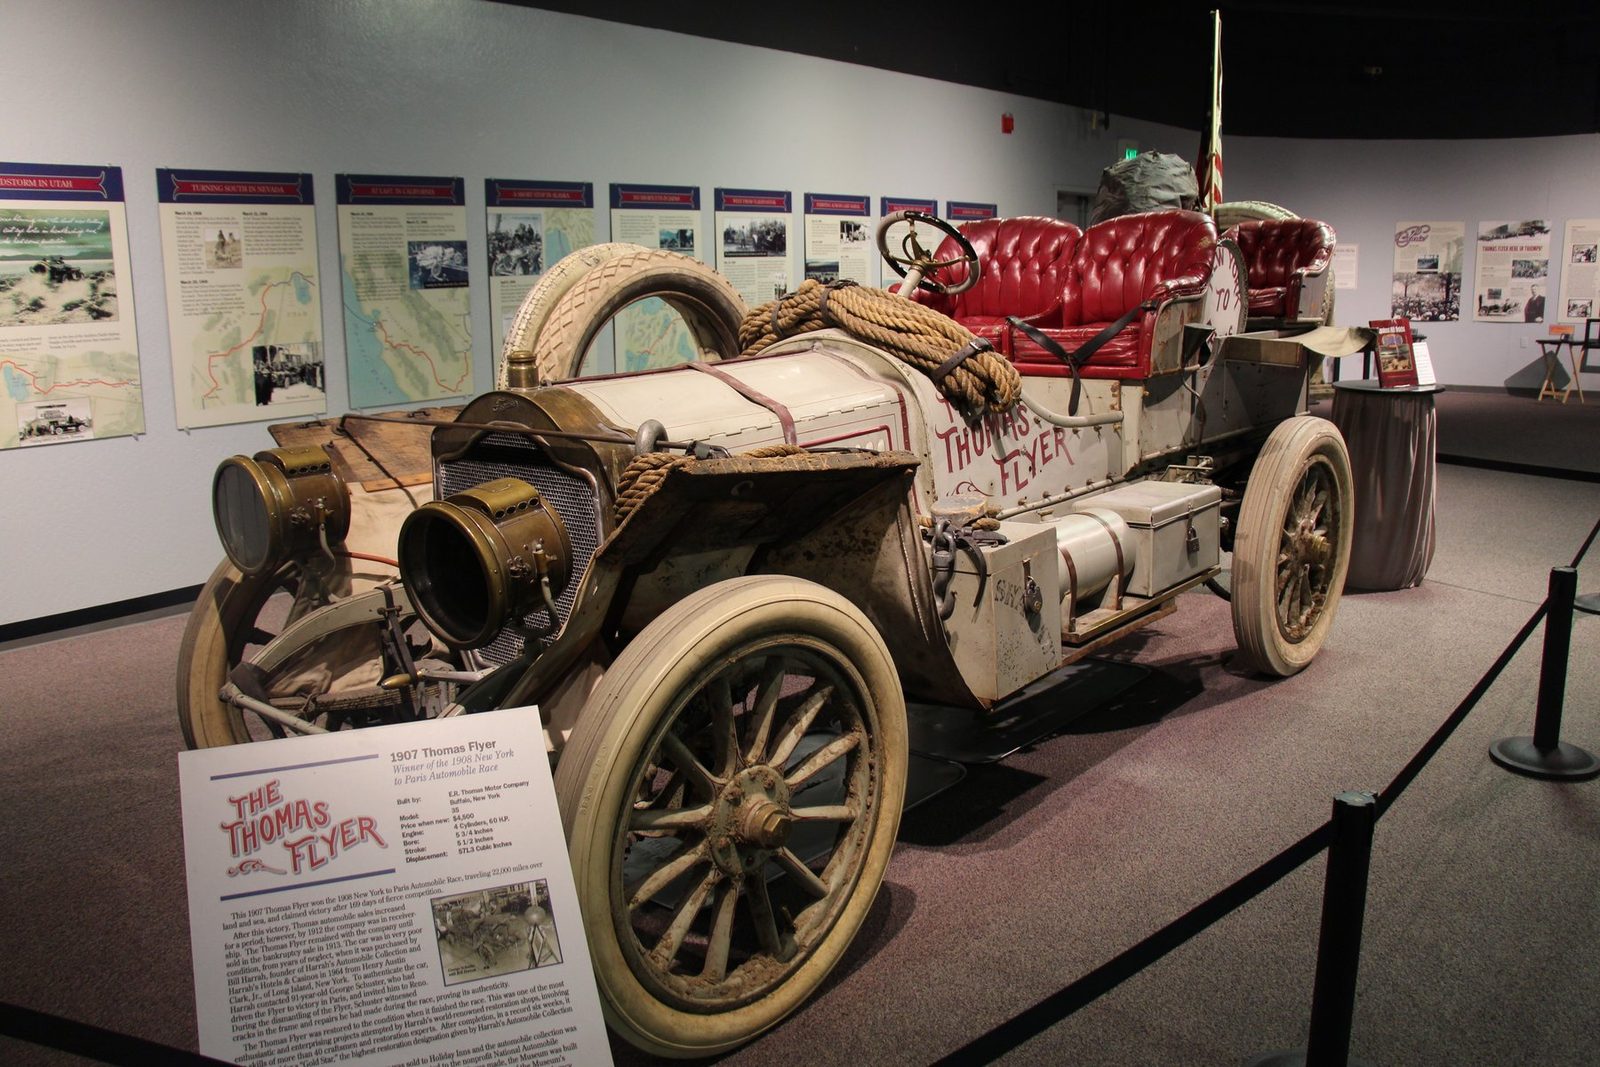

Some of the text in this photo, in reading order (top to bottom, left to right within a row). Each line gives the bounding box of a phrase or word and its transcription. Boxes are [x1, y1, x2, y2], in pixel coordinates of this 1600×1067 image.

[0, 178, 73, 188] DSTORM IN UTAH
[192, 182, 285, 194] TURNING SOUTH IN NEVADA
[1215, 287, 1230, 312] TO
[935, 403, 1030, 473] THOMAS
[991, 427, 1075, 496] FLYER
[390, 741, 497, 762] 1907 Thomas Flyer
[392, 748, 515, 774] Winner of the 1908 New York
[394, 764, 499, 785] to Paris Automobile Race
[229, 780, 283, 820] THE
[221, 800, 330, 857] THOMAS
[453, 812, 474, 822] $4,500
[459, 820, 487, 829] Cylinders,
[283, 816, 389, 875] FLYER
[404, 846, 427, 854] Stroke:
[405, 851, 448, 863] Displacement:
[231, 911, 246, 920] This
[248, 908, 263, 917] 1907
[265, 905, 291, 914] Thomas
[292, 902, 309, 910] Flyer
[369, 888, 384, 896] York
[393, 884, 409, 892] Paris
[410, 878, 445, 889] Automobile
[464, 871, 491, 880] traveling
[223, 921, 238, 930] land
[239, 918, 252, 927] and
[268, 914, 280, 922] and
[281, 909, 307, 920] claimed
[308, 907, 331, 915] victory
[233, 903, 406, 940] After this victory, Thomas automobile sales increased
[266, 933, 296, 942] however,
[297, 930, 306, 938] by
[308, 926, 323, 935] 1912
[336, 921, 366, 930] company
[225, 950, 242, 959] ship.
[245, 947, 258, 955] The
[260, 944, 287, 953] Thomas
[289, 940, 306, 948] Flyer
[308, 932, 339, 944] remained
[341, 929, 355, 938] with
[368, 924, 397, 934] company
[398, 919, 413, 928] until
[226, 958, 240, 968] sold
[250, 956, 260, 964] the
[263, 949, 301, 961] bankruptcy
[303, 946, 315, 954] sale
[344, 938, 357, 947] The
[408, 928, 423, 937] poor
[228, 977, 240, 986] Bill
[269, 968, 295, 978] founder
[297, 965, 304, 973] of
[305, 960, 334, 972] Harrah's
[336, 953, 373, 966] Automobile
[375, 948, 408, 959] Collection
[409, 944, 421, 953] and
[232, 989, 417, 1032] During the dismantling of the Flyer, Schuster witnessed
